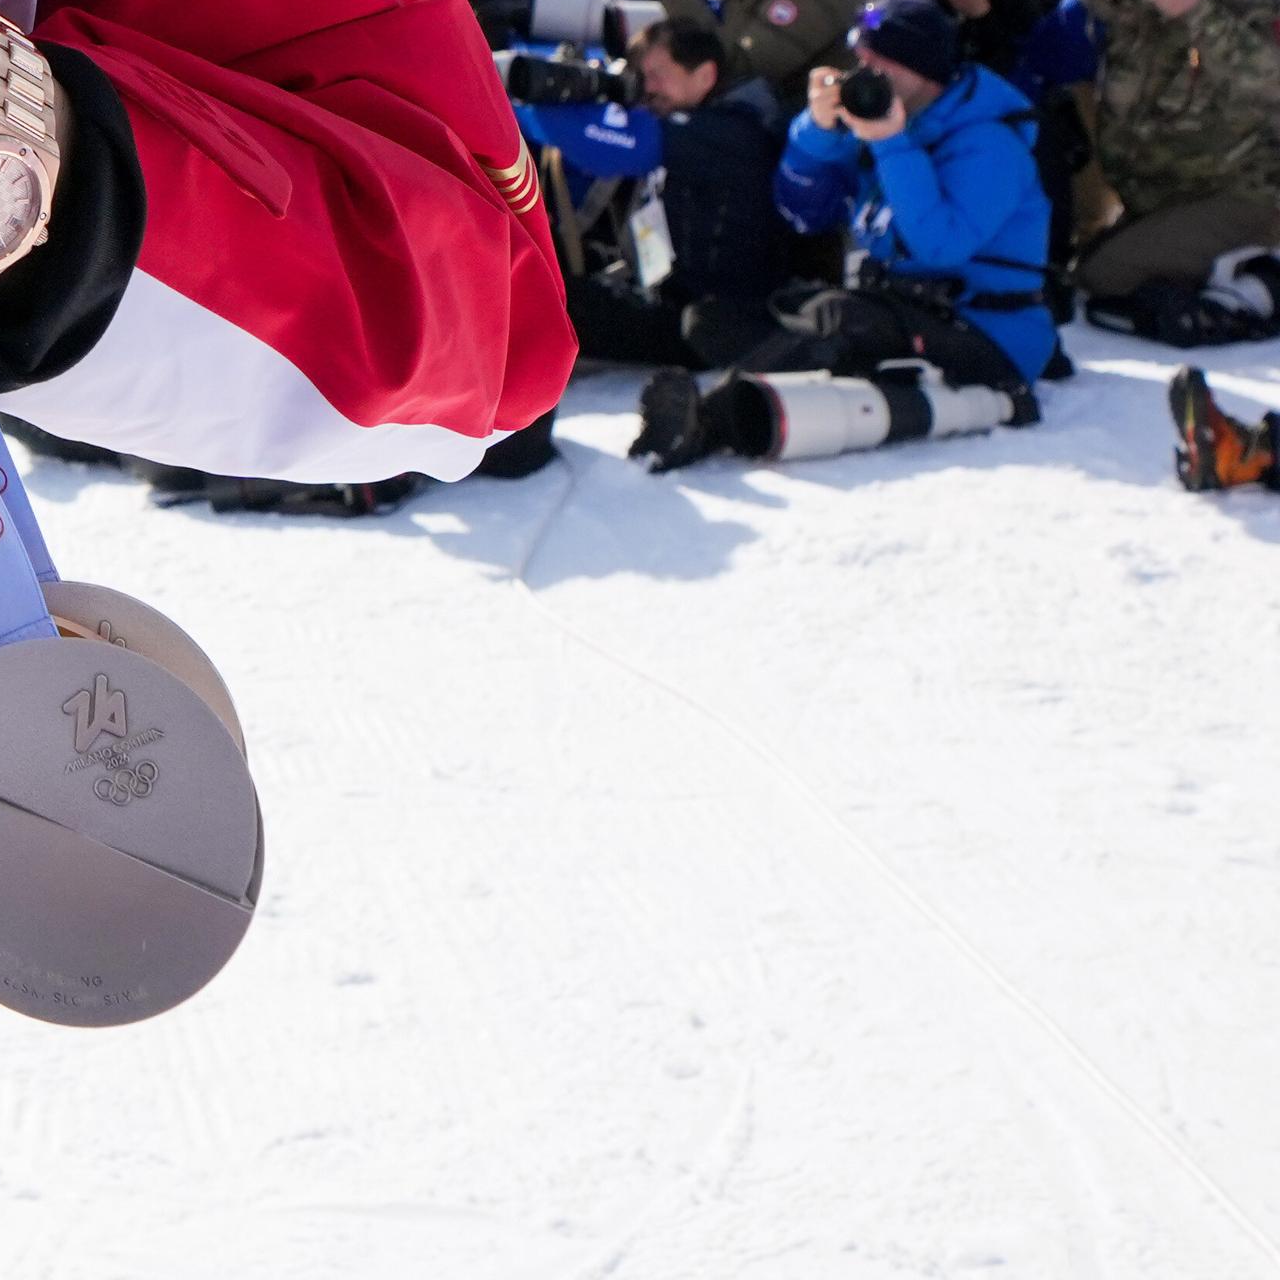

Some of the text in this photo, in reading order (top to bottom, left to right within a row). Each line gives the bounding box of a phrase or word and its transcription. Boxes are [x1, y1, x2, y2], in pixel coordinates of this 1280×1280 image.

[64, 727, 166, 776] MILANO CORTINA
[104, 752, 131, 771] 2026
